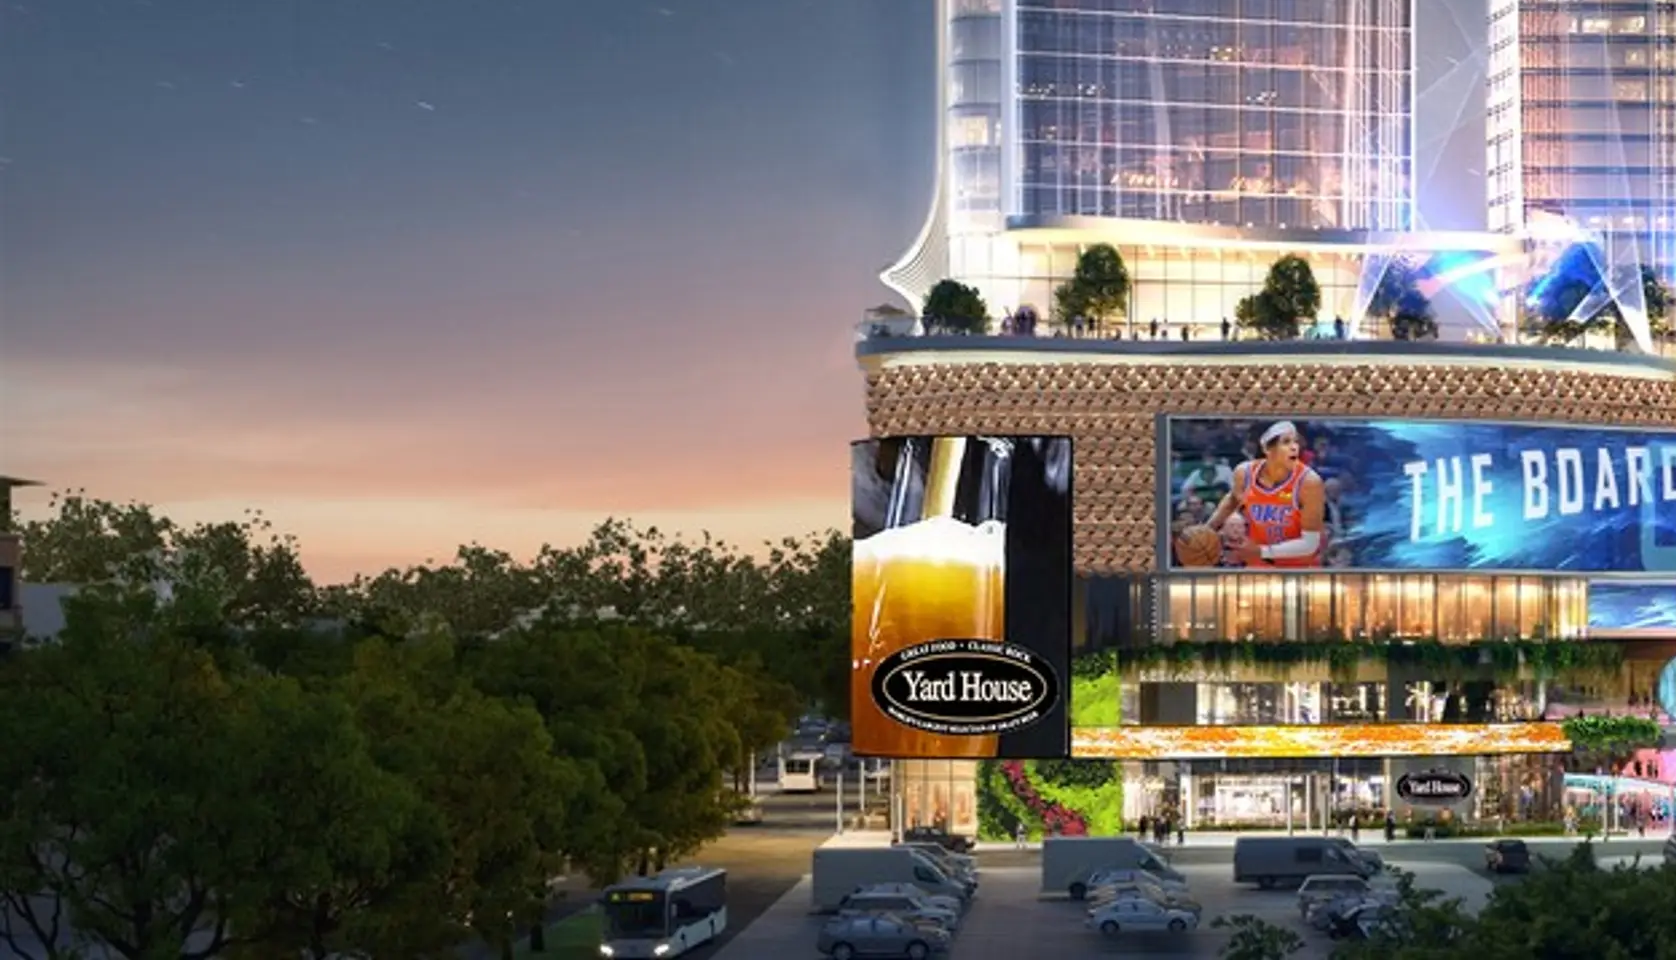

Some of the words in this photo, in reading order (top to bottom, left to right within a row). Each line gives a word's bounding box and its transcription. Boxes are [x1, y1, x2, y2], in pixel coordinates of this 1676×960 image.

[1403, 453, 1494, 541] THE
[902, 671, 956, 701] Yard
[960, 671, 1033, 701] House
